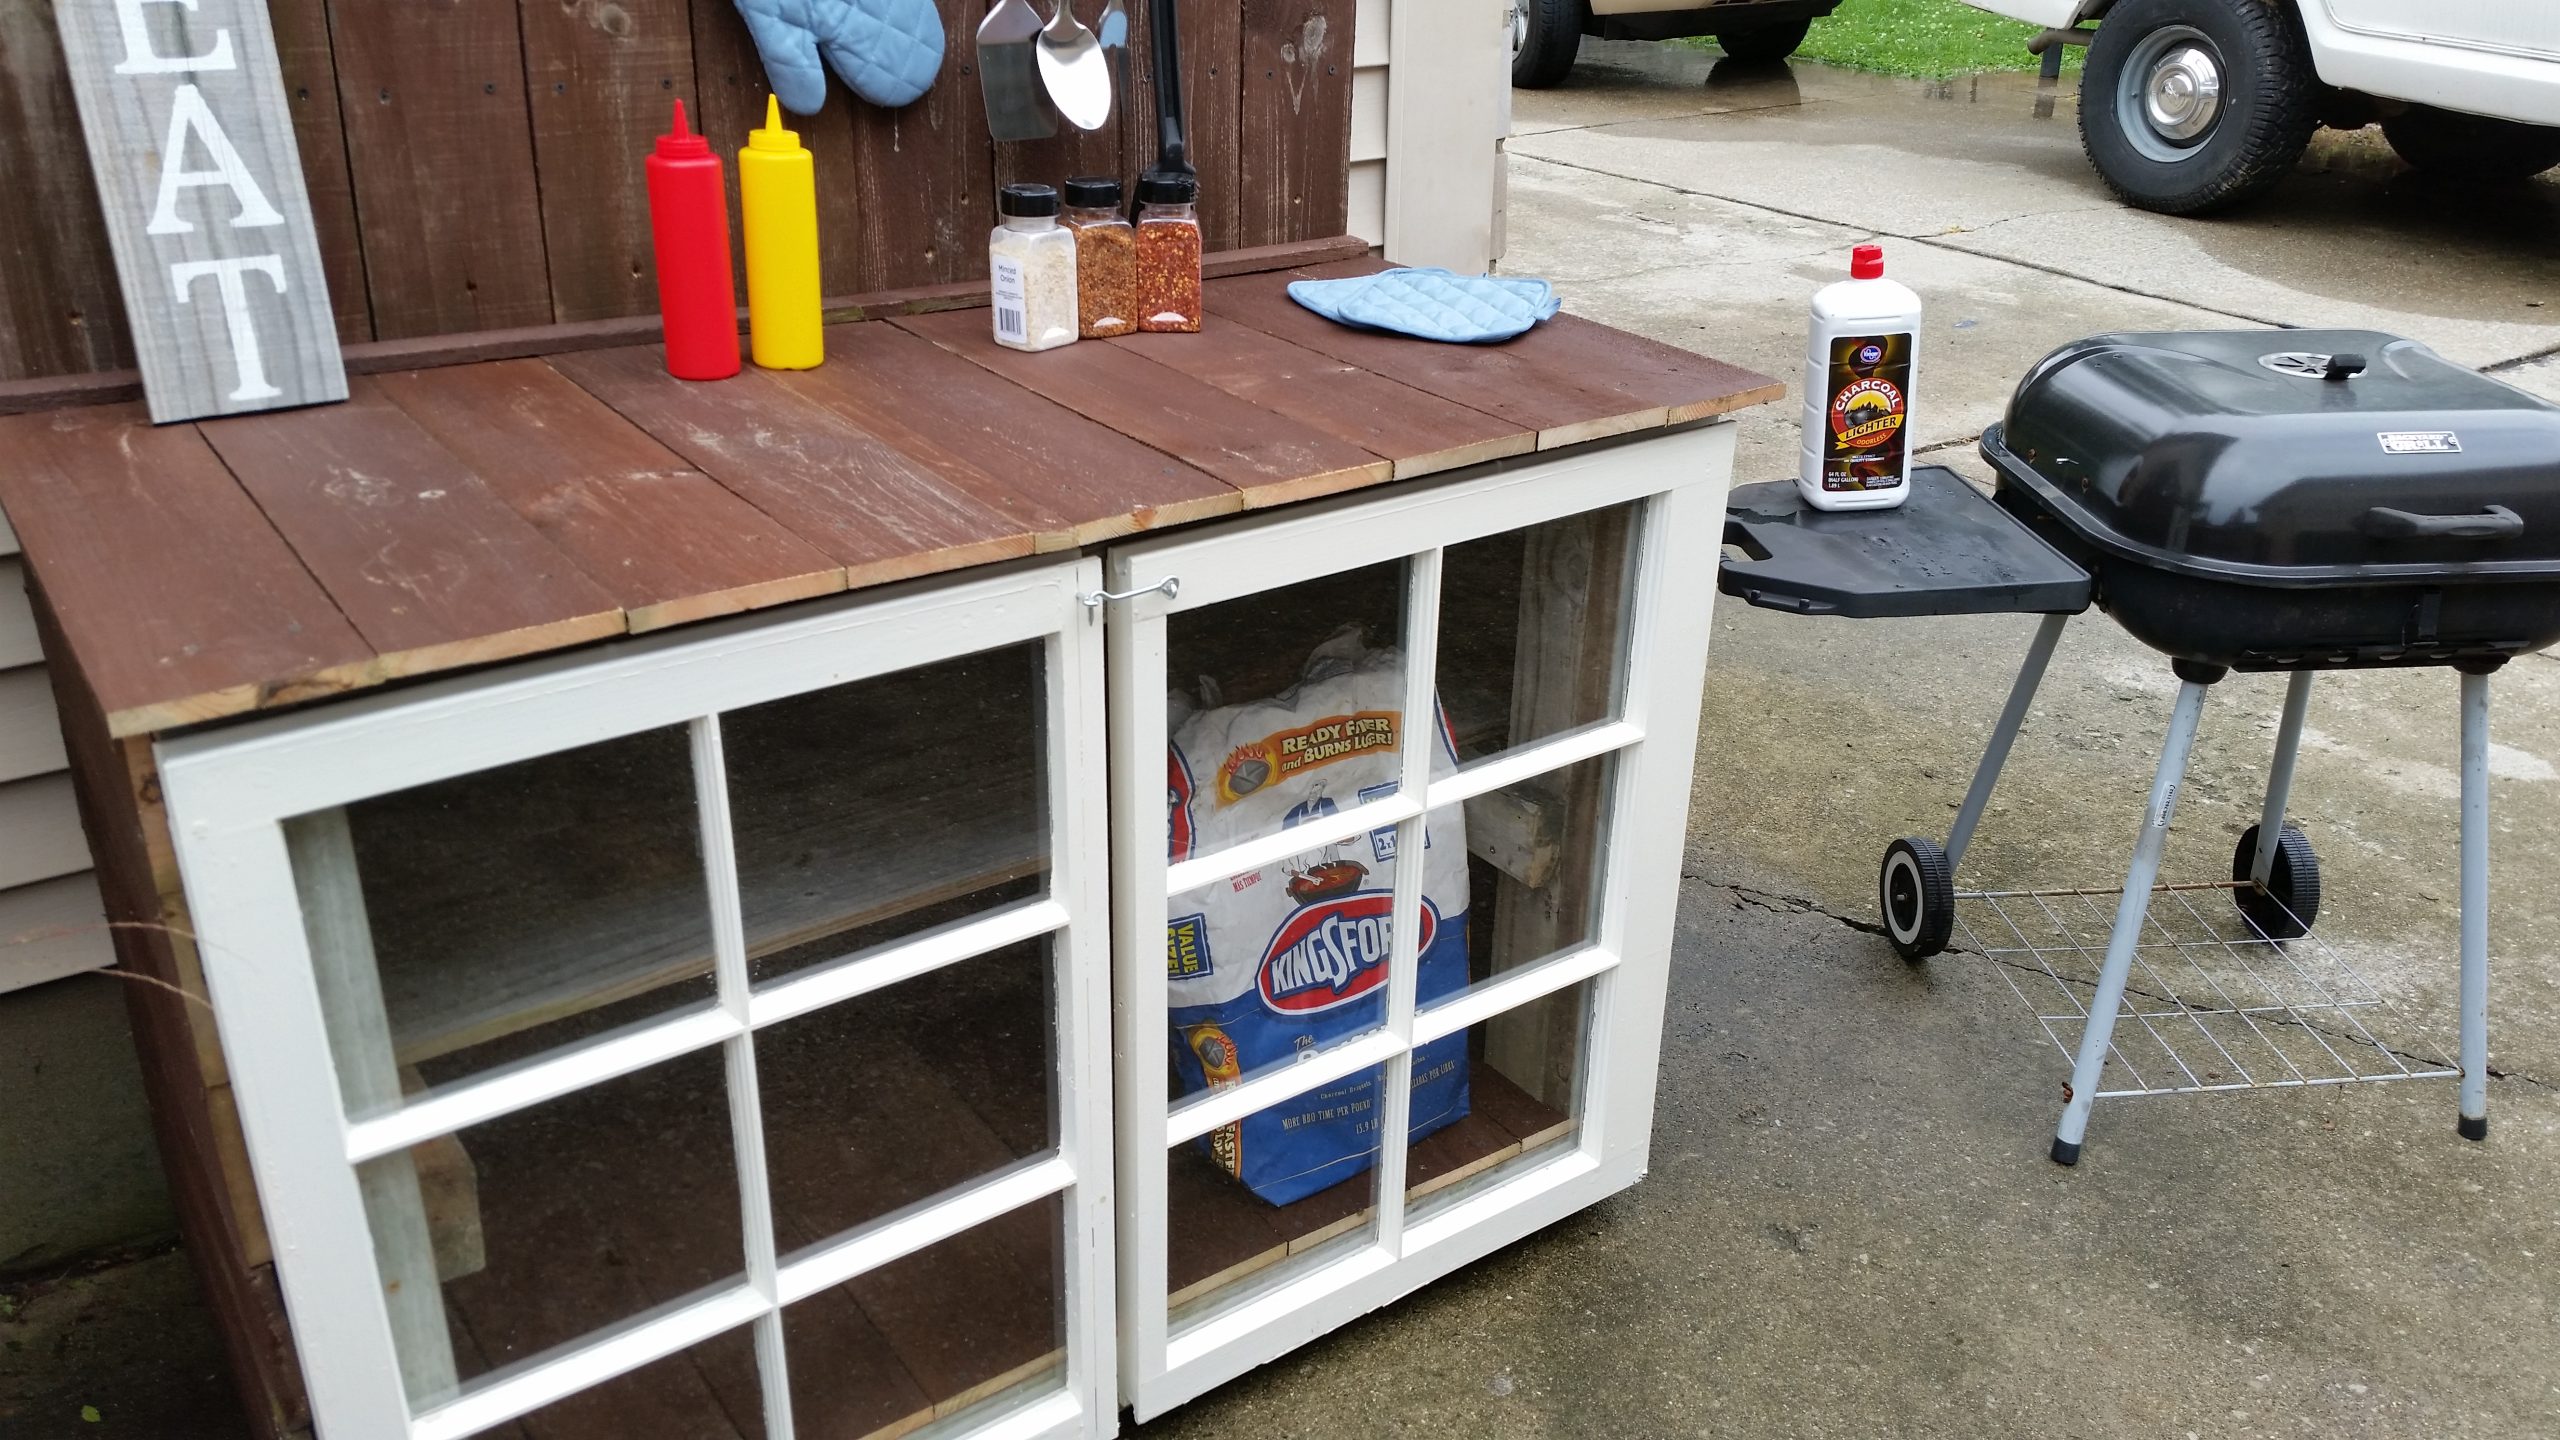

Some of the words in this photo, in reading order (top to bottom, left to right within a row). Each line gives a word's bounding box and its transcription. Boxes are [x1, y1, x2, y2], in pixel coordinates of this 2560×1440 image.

[114, 0, 288, 402] EAT
[998, 265, 1017, 275] Minced
[1000, 274, 1015, 284] Onion
[1835, 380, 1901, 411] CHARCOAL
[1845, 416, 1897, 440] LIGHTER
[1856, 433, 1887, 446] ODORLESS
[1282, 725, 1341, 755] READY
[1281, 756, 1301, 772] and
[1304, 740, 1352, 763] BURNS
[1178, 922, 1199, 974] VALUE
[1271, 915, 1392, 995] KINGSFOR
[1294, 1034, 1317, 1052] The
[1320, 1089, 1347, 1099] Charcoal
[1282, 1116, 1300, 1130] MORE
[1318, 1108, 1335, 1120] TIME
[1337, 1106, 1349, 1117] PER
[1351, 1099, 1371, 1113] POUND
[1356, 1121, 1369, 1134] 15.9
